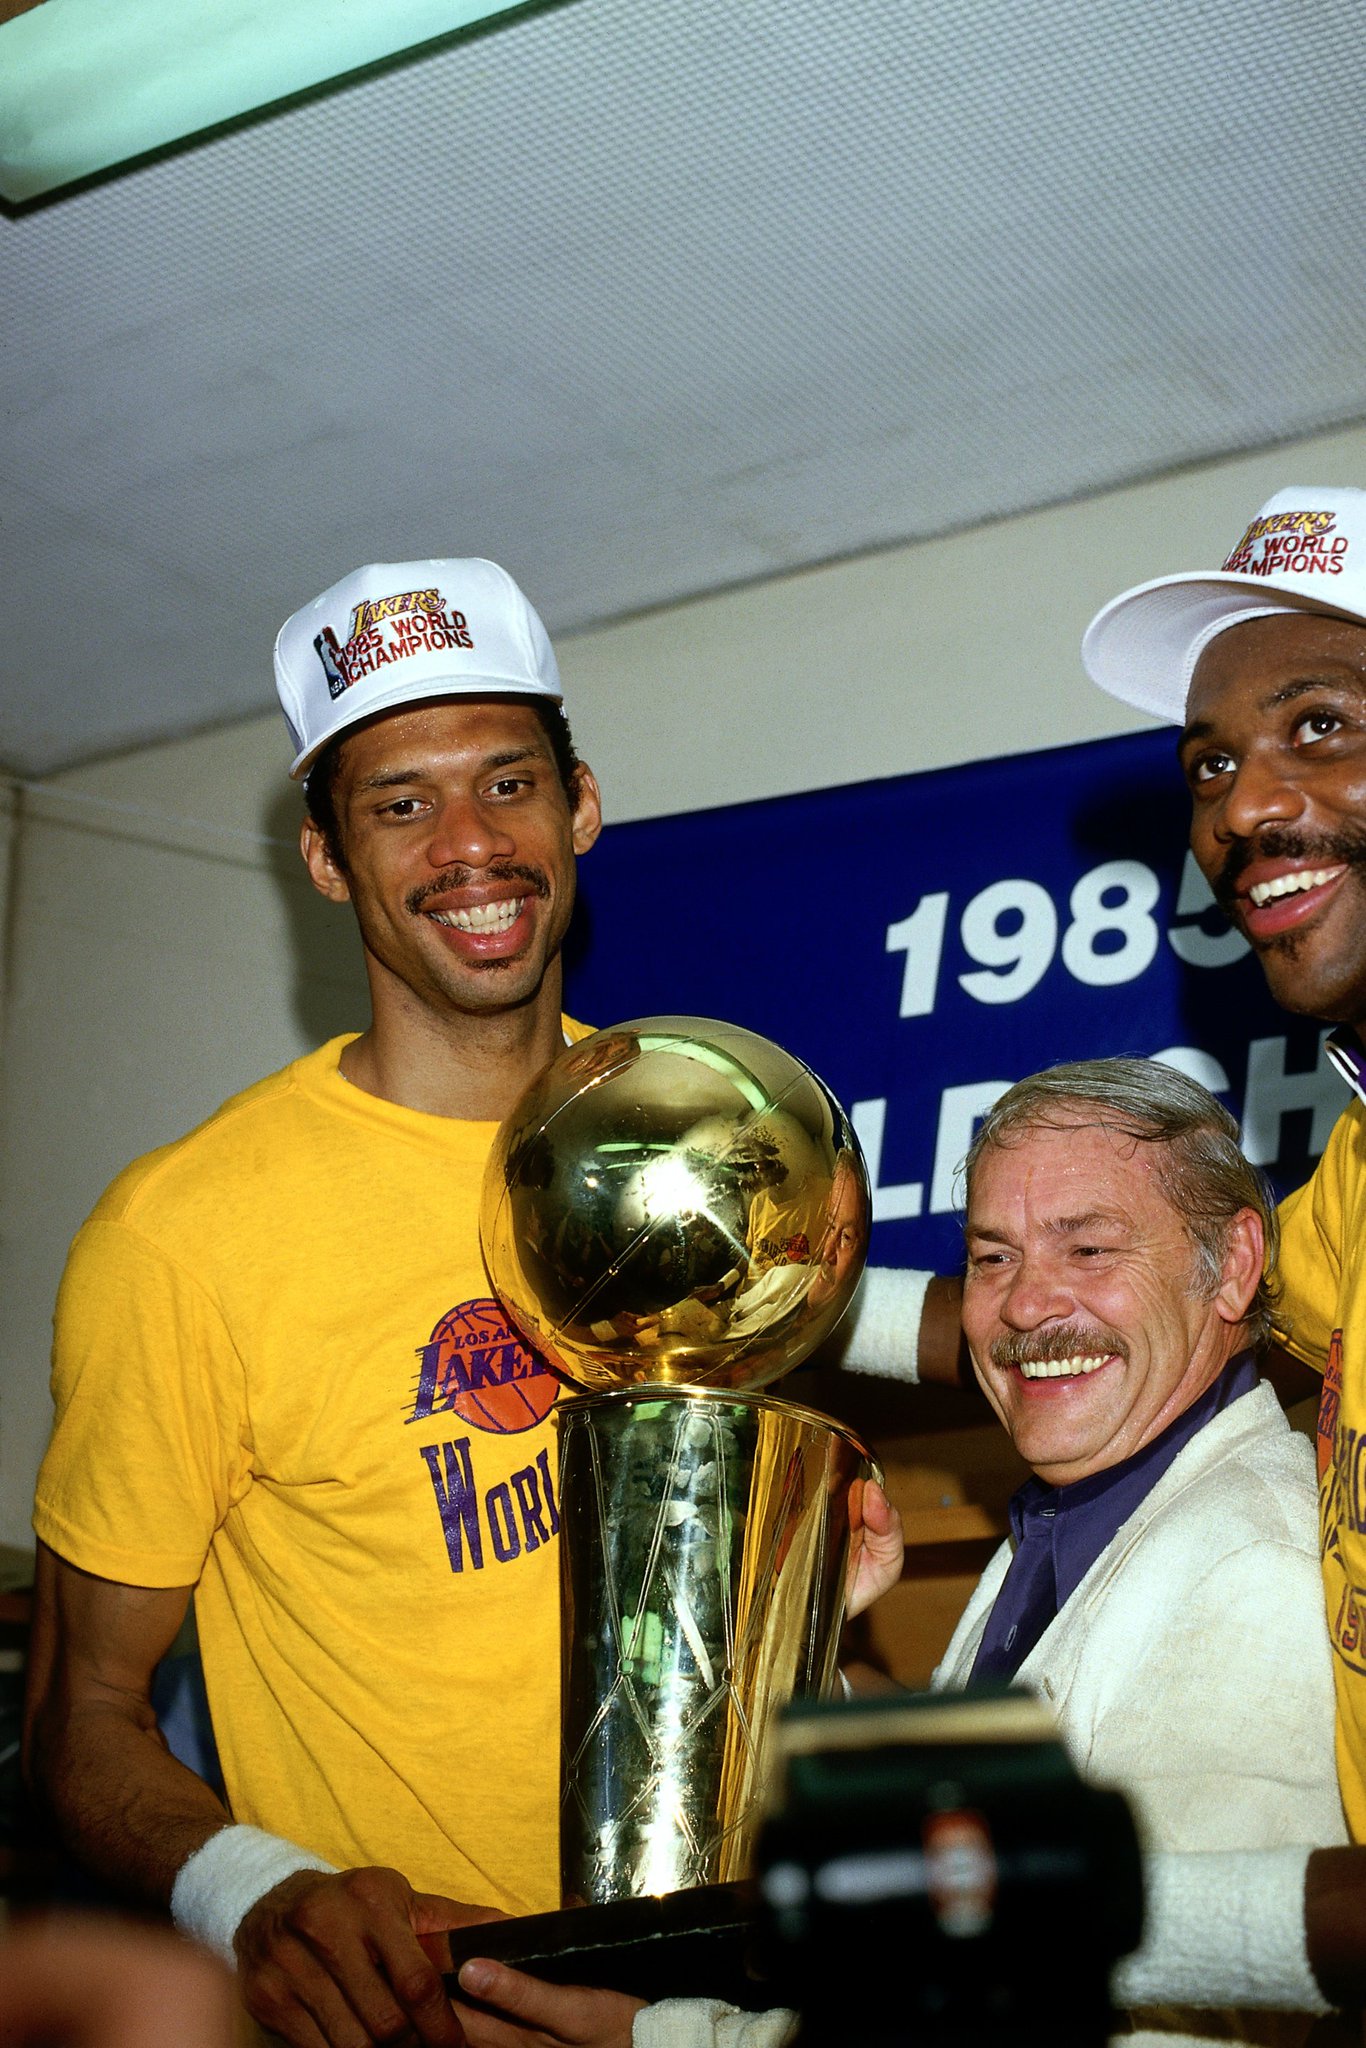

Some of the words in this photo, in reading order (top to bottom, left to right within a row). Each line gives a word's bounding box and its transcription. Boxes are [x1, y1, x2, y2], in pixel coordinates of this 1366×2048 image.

[1264, 535, 1349, 557] WORLD
[340, 627, 384, 666] 1985
[390, 610, 468, 638] WORLD
[350, 588, 447, 641] LAKERS
[348, 629, 475, 683] CHAMPIONS
[453, 1330, 490, 1350] LOS
